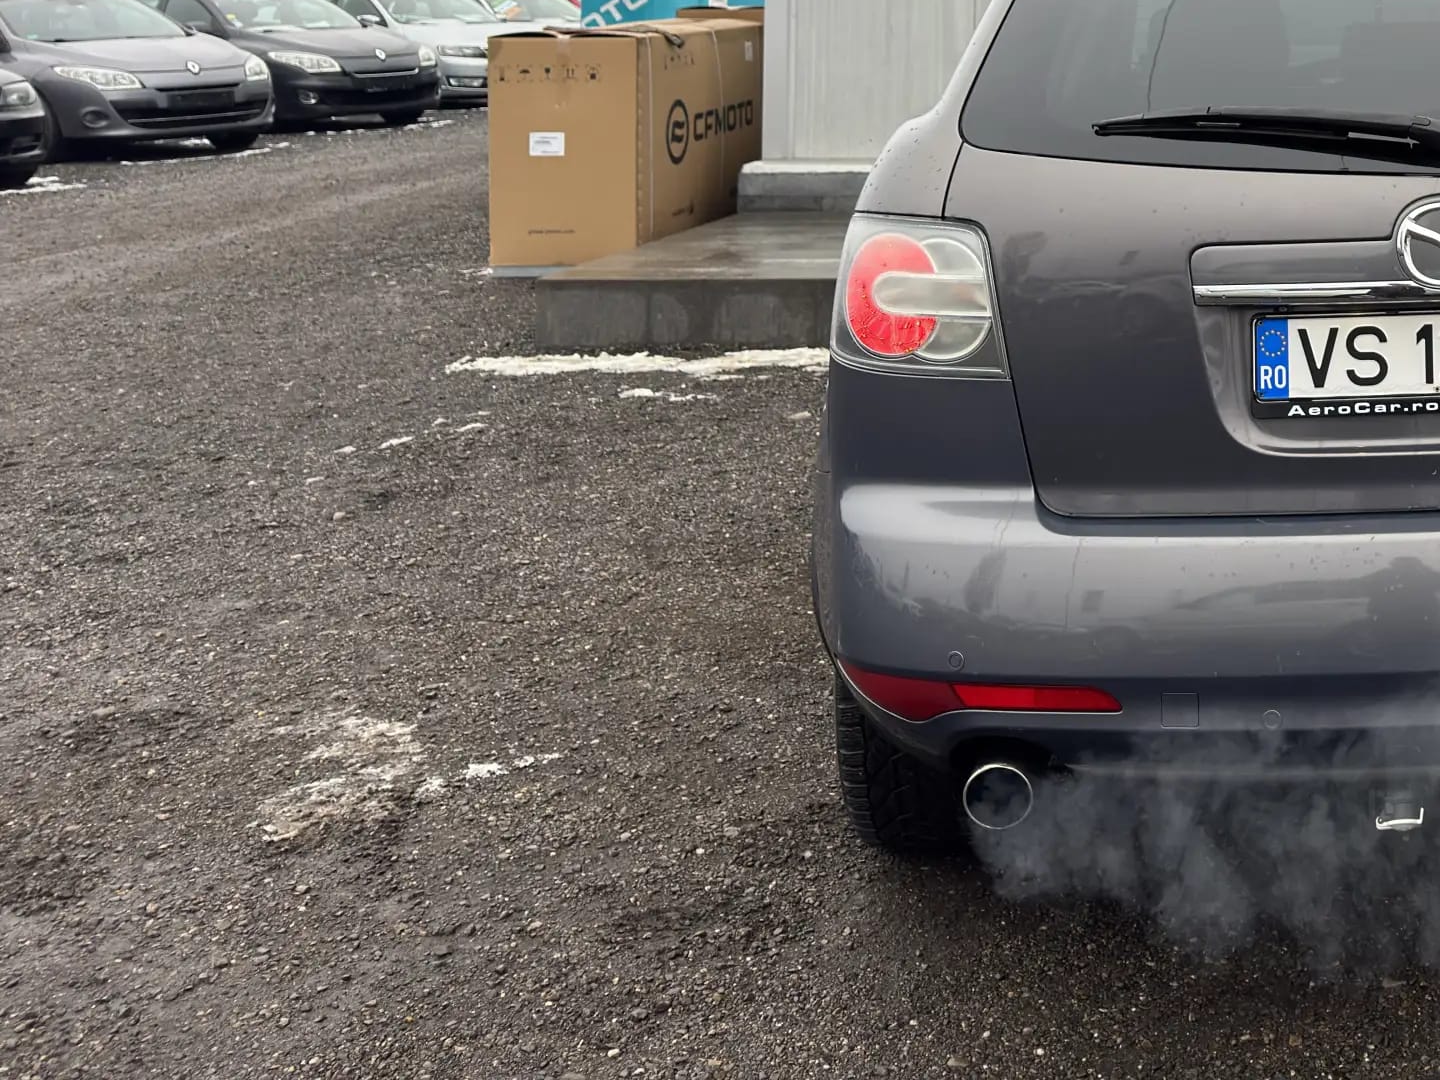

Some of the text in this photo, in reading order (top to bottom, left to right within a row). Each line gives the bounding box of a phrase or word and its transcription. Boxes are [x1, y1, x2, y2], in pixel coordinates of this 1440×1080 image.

[693, 99, 754, 142] CFMOTO
[1297, 325, 1389, 389] VS
[1260, 365, 1287, 390] RO
[1287, 401, 1440, 418] AeroCar.ro
